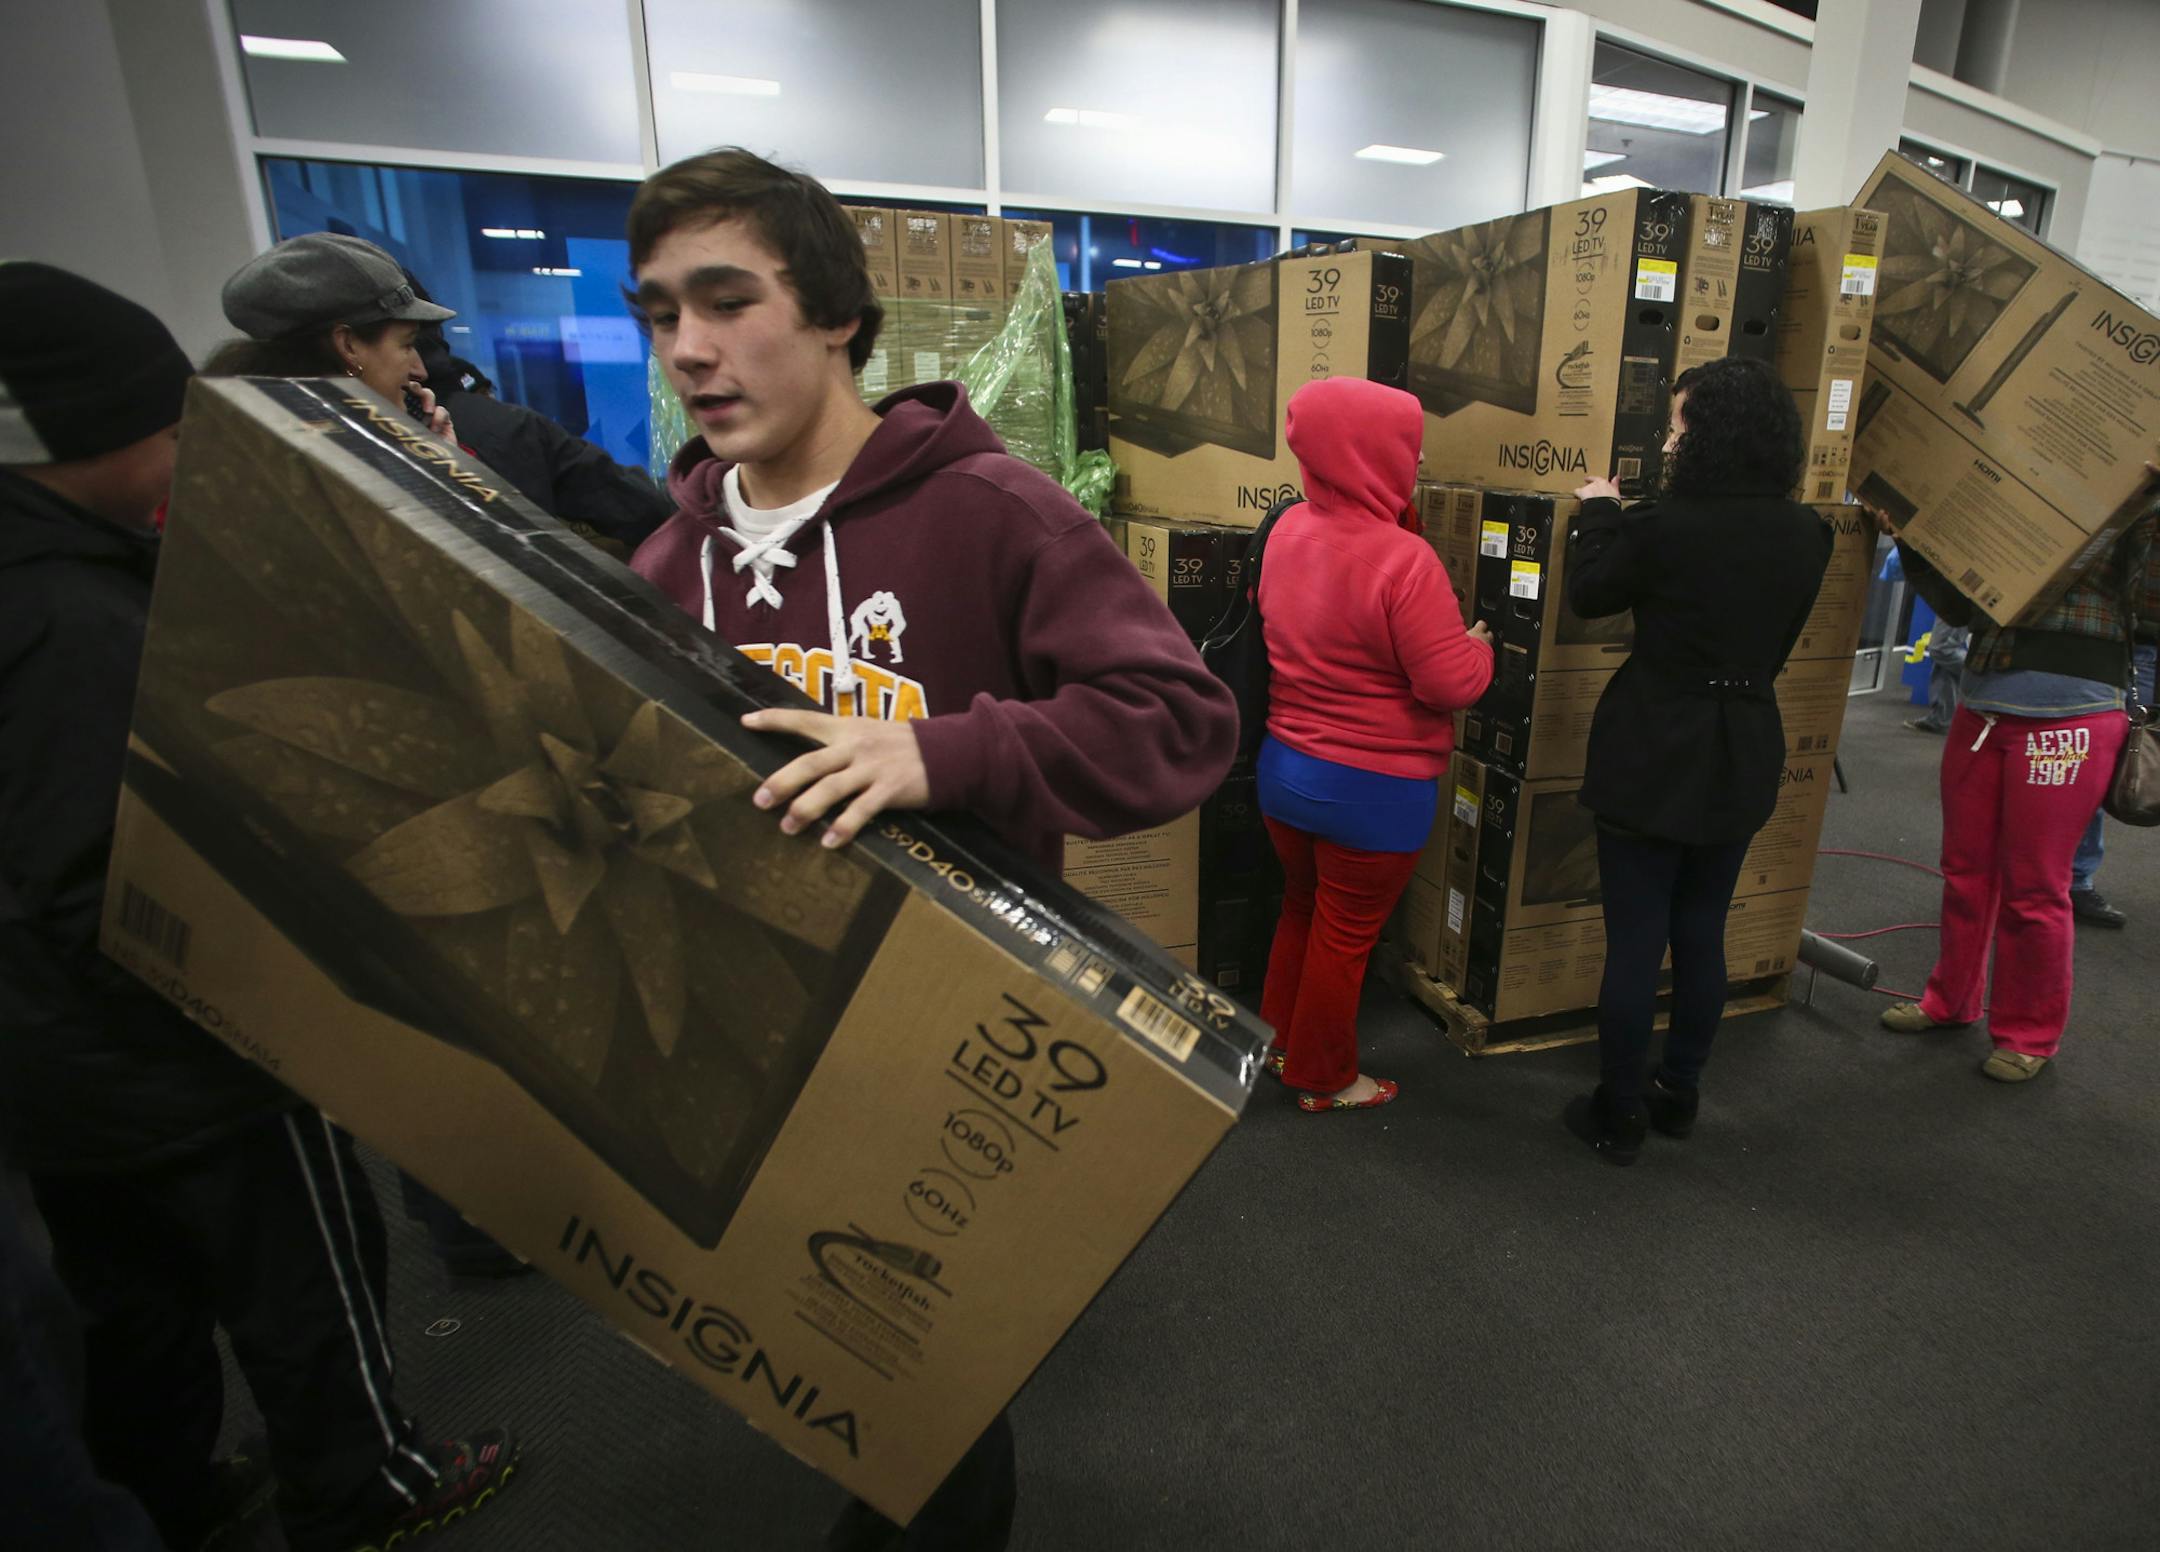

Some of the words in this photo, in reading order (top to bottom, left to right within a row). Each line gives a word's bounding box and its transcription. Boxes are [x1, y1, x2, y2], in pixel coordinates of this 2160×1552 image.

[1575, 207, 1608, 237] 39
[1639, 221, 1670, 242] 39
[1572, 240, 1590, 255] LED
[1590, 237, 1605, 251] TV
[1638, 242, 1654, 254] LED
[1654, 244, 1668, 255] TV
[1746, 234, 1774, 255] 39
[1744, 255, 1760, 266] LED
[1761, 256, 1772, 267] TV
[1306, 268, 1341, 294] 39
[1575, 271, 1594, 284] 1080p
[1305, 297, 1324, 310] LED
[1325, 296, 1340, 309] TV
[1375, 284, 1399, 302] 39
[1374, 302, 1389, 314] LED
[1389, 303, 1399, 315] TV
[1310, 328, 1333, 338] 1080p
[2090, 309, 2160, 365] INSIG
[343, 398, 499, 503] INSIGNIA
[1498, 440, 1588, 476] INSIGNIA
[1515, 525, 1537, 545] 39
[1140, 536, 1156, 558] 39
[1173, 558, 1203, 575] 39
[1173, 575, 1190, 584] LED
[1191, 575, 1203, 584] TV
[2025, 728, 2090, 757] AERO
[2026, 758, 2081, 786] 1987
[1486, 793, 1505, 814] 39
[1184, 972, 1236, 1018] 39
[1207, 1010, 1230, 1030] TV
[976, 992, 1108, 1093] 39
[952, 1039, 1023, 1100] LED
[1030, 1089, 1080, 1134] TV
[943, 1111, 1014, 1174] 1080p
[908, 1179, 969, 1229] 60Hz
[856, 1254, 930, 1311] rocketfish
[558, 1215, 859, 1459] INSIGNIA
